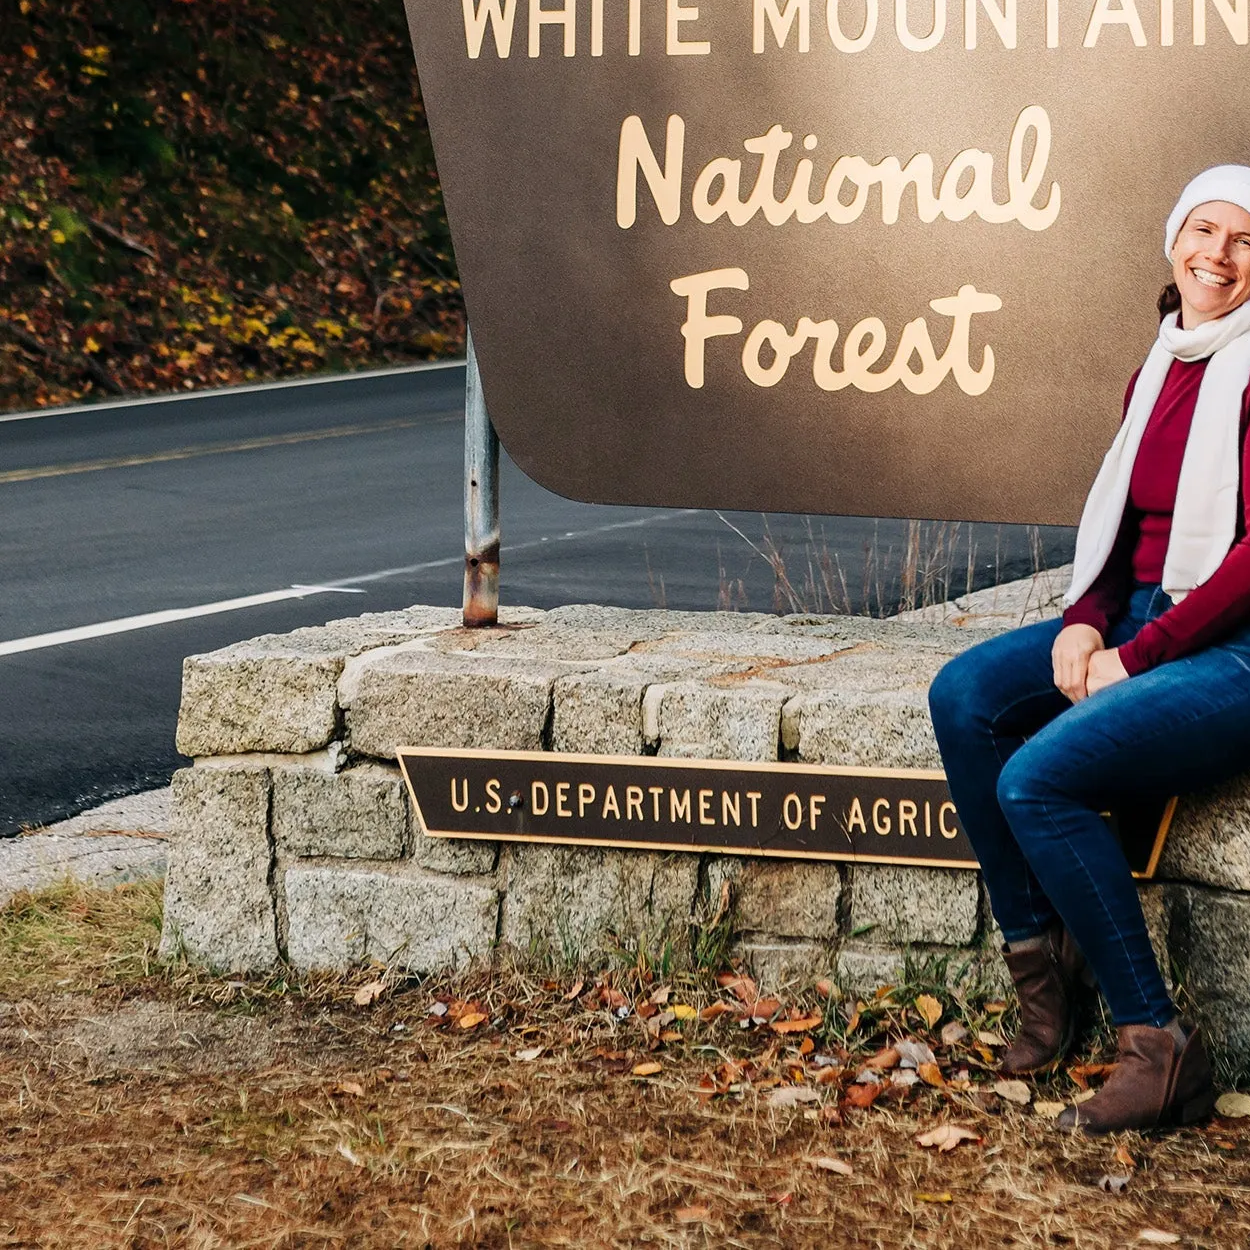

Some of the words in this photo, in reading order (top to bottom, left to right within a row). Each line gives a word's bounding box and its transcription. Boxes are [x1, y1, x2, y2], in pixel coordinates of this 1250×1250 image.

[616, 104, 1062, 232] National
[669, 266, 1003, 396] Forest
[451, 777, 512, 815] U.S.
[531, 781, 763, 828] DEPARTMENT
[782, 793, 826, 831] OF
